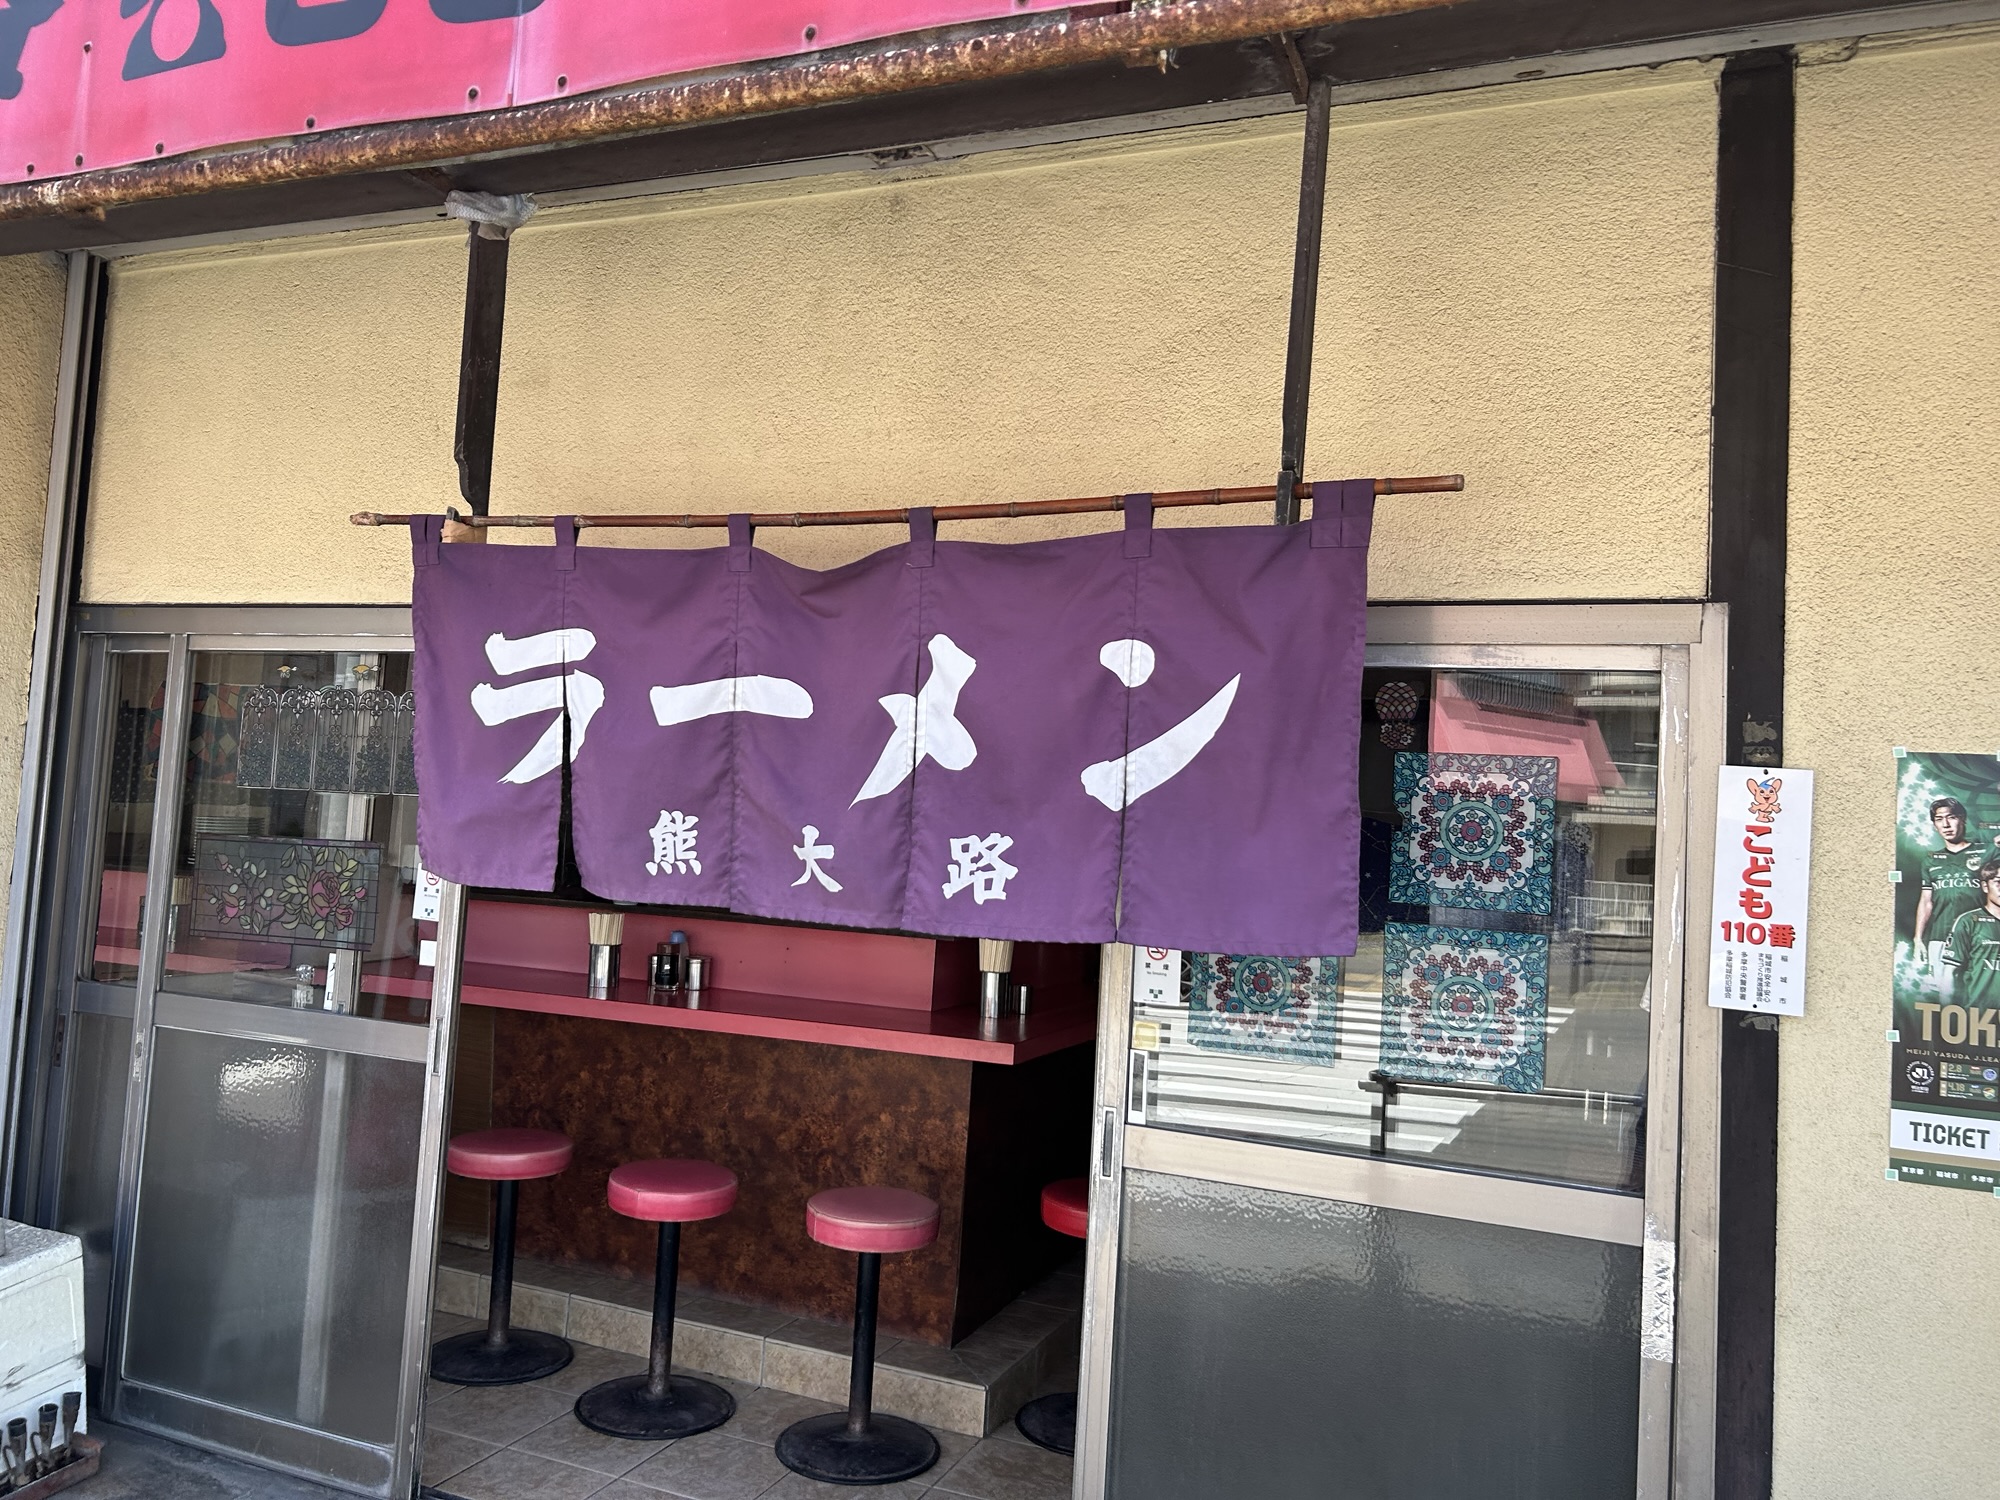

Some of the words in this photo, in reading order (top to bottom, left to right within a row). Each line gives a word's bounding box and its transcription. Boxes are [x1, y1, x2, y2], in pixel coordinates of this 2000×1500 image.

[470, 628, 1241, 812] ラーメン
[645, 809, 1019, 905] 熊大路
[1738, 824, 1775, 920] こども
[1931, 878, 1981, 891] NICIGAS
[1720, 920, 1796, 949] 110番
[1914, 1002, 2000, 1048] TOK
[1906, 1048, 1930, 1056] MEIJI
[1933, 1051, 1971, 1060] YASUDA
[1909, 1120, 1990, 1150] TICKET
